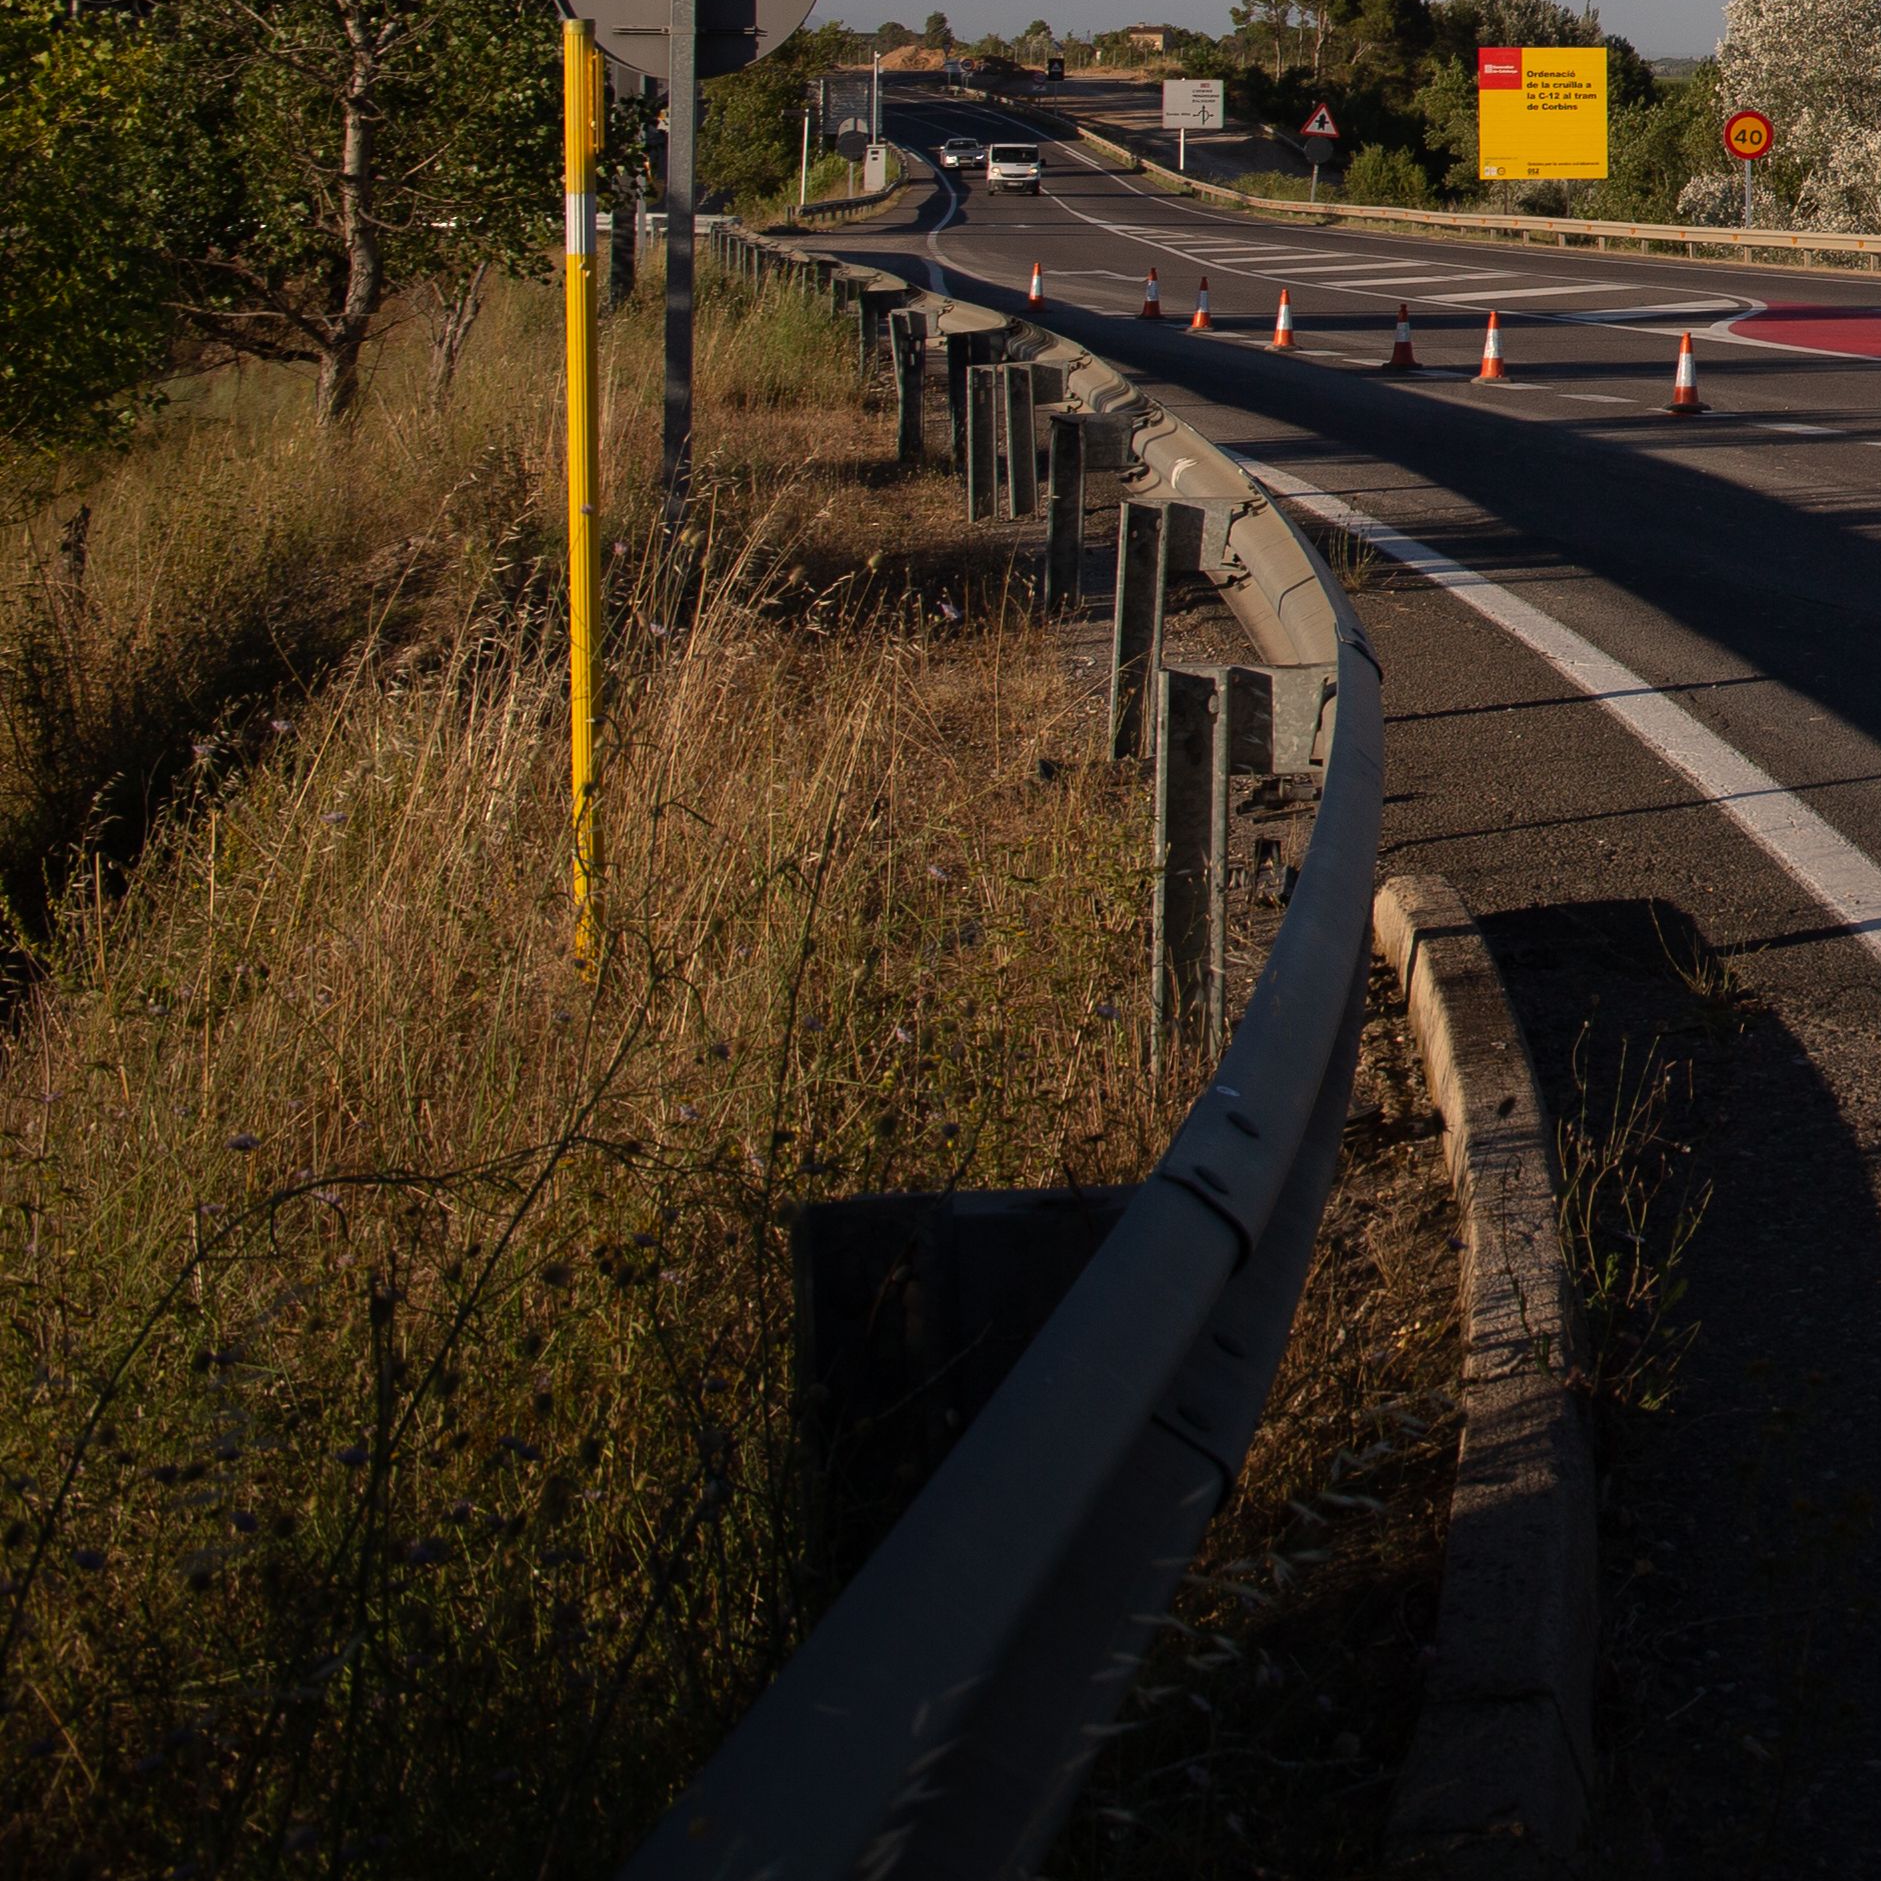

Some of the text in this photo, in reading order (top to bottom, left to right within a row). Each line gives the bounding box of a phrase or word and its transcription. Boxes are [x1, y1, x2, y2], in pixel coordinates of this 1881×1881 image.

[1527, 70, 1576, 78] Ordenació
[1526, 81, 1539, 89] de
[1541, 81, 1550, 89] la
[1527, 92, 1597, 100] la C-12 al tram
[1526, 103, 1578, 111] de Corbins
[1734, 128, 1763, 146] 40
